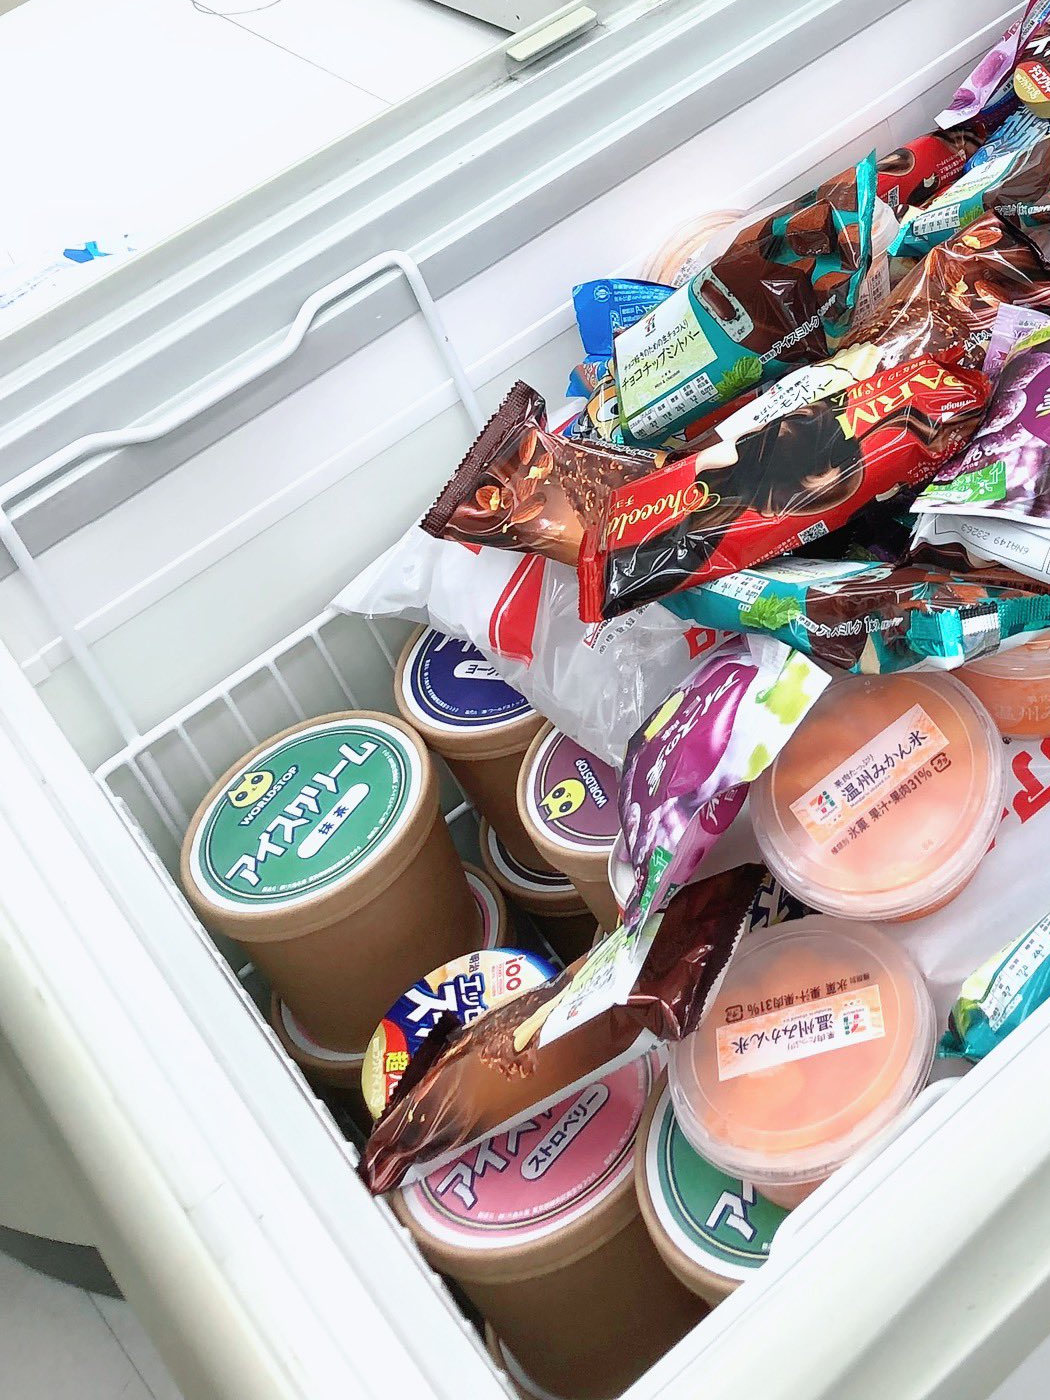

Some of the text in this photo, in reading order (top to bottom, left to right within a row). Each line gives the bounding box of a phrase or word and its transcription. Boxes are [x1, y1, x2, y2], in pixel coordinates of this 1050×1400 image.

[621, 330, 700, 392] チョコチップミントバー
[773, 316, 820, 354] アイスミルク
[575, 758, 608, 809] WORLDSTOP
[841, 730, 927, 803] 温州みかん氷
[224, 740, 381, 887] アイスクリーム
[240, 764, 300, 827] WORLDSTOP
[318, 804, 350, 837] 抹茶
[847, 821, 870, 841] 氷菓
[869, 768, 933, 823] 果汁・果肉31%
[747, 983, 822, 1016] 果汁・果肉31%
[824, 977, 848, 995] 氷菓
[733, 1014, 834, 1055] 温州みかん氷
[528, 1086, 605, 1172] ストロベリー
